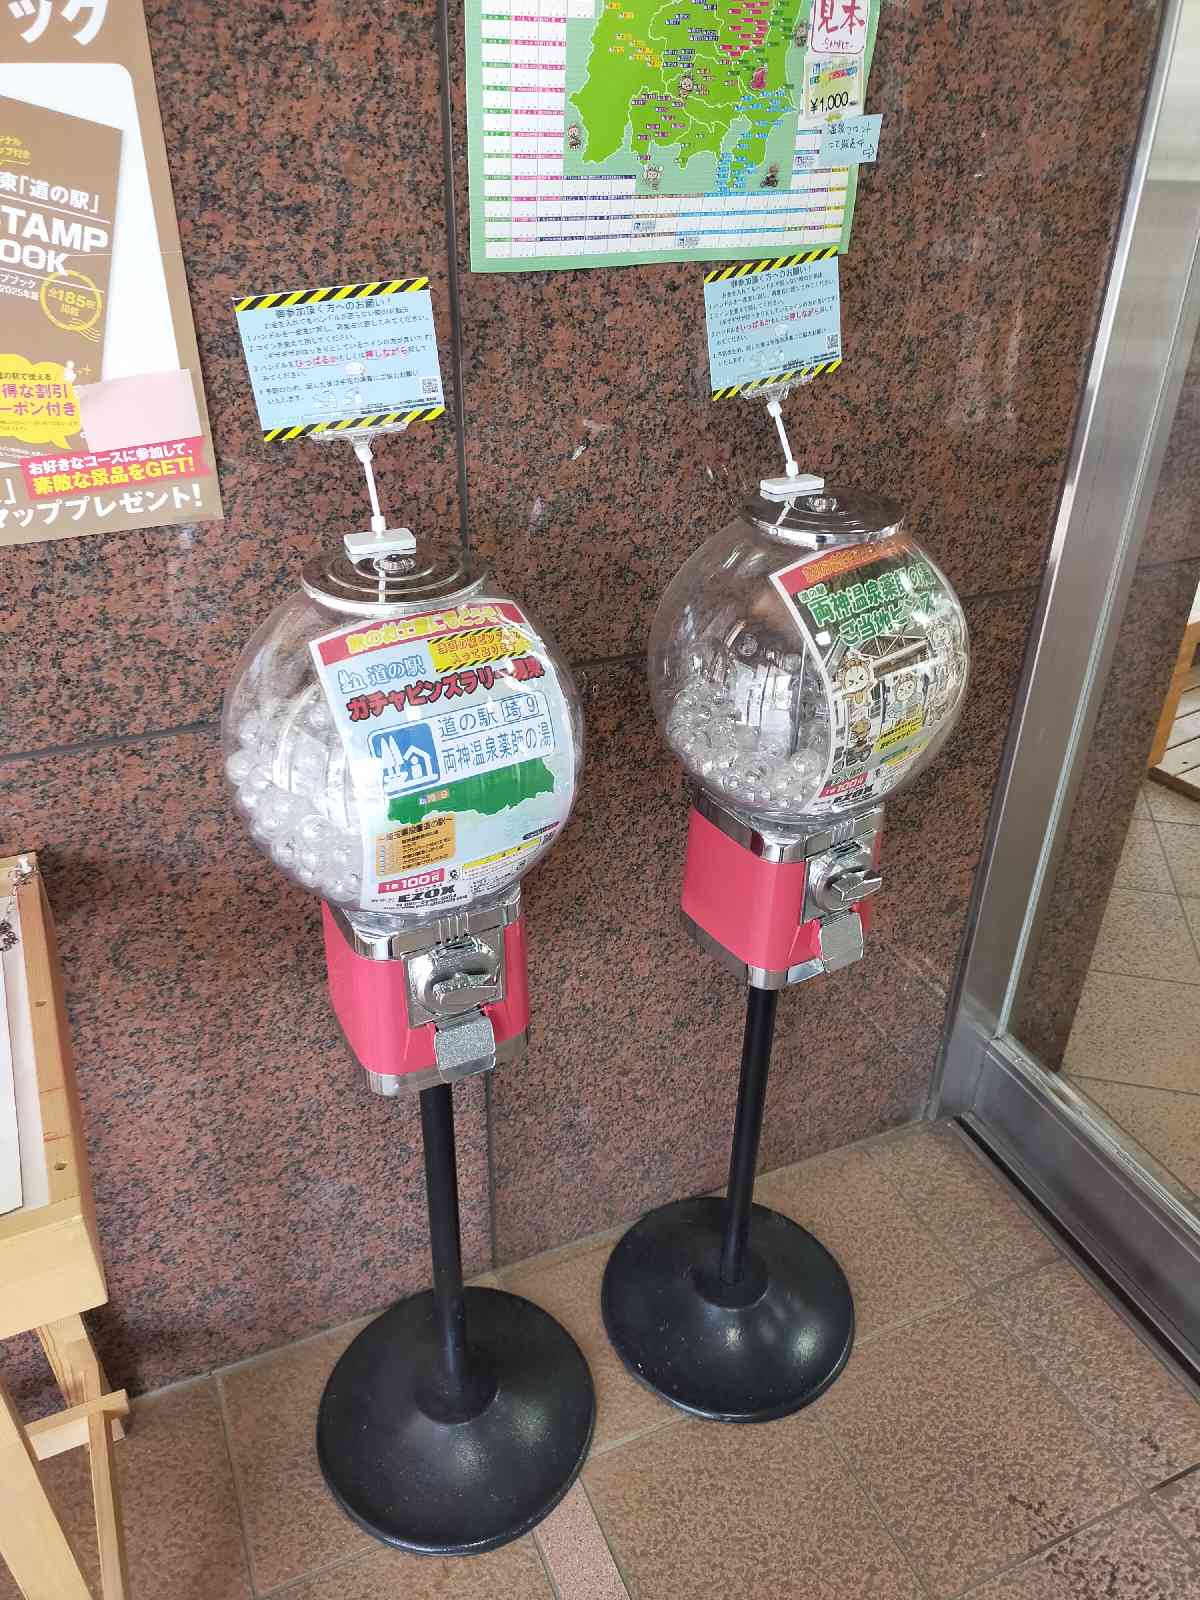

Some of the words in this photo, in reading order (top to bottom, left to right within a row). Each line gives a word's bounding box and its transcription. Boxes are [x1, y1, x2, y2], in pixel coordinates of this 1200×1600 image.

[817, 0, 865, 34] 見本
[810, 91, 849, 113] ¥1,000
[0, 205, 108, 252] TAMP
[368, 653, 426, 686] 道の駅
[439, 706, 498, 737] 道の駅
